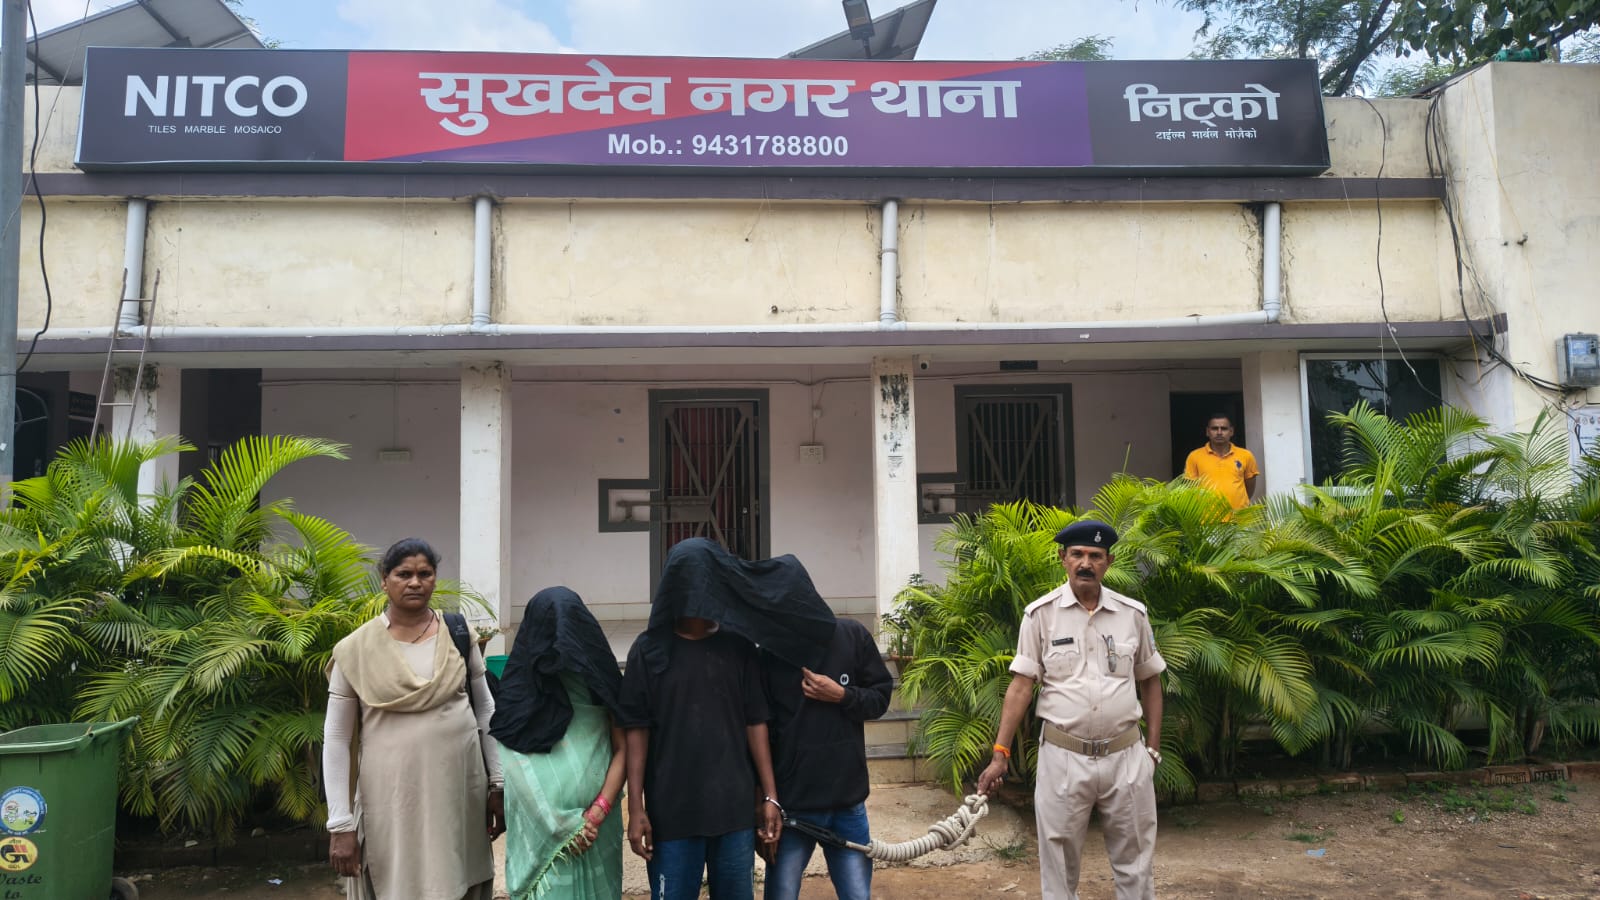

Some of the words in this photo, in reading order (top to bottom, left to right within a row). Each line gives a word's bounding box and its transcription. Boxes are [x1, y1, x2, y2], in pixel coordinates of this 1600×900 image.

[124, 75, 308, 117] NITCO
[419, 59, 672, 136] सुखदेव
[688, 77, 856, 118] नगर
[870, 80, 1022, 118] थाना
[1123, 83, 1280, 127] निट्को
[148, 125, 177, 134] TILES
[184, 125, 226, 134] MARBLE
[234, 125, 282, 134] MOSAICO
[607, 133, 682, 155] Mob.:
[692, 135, 849, 156] 9431788800
